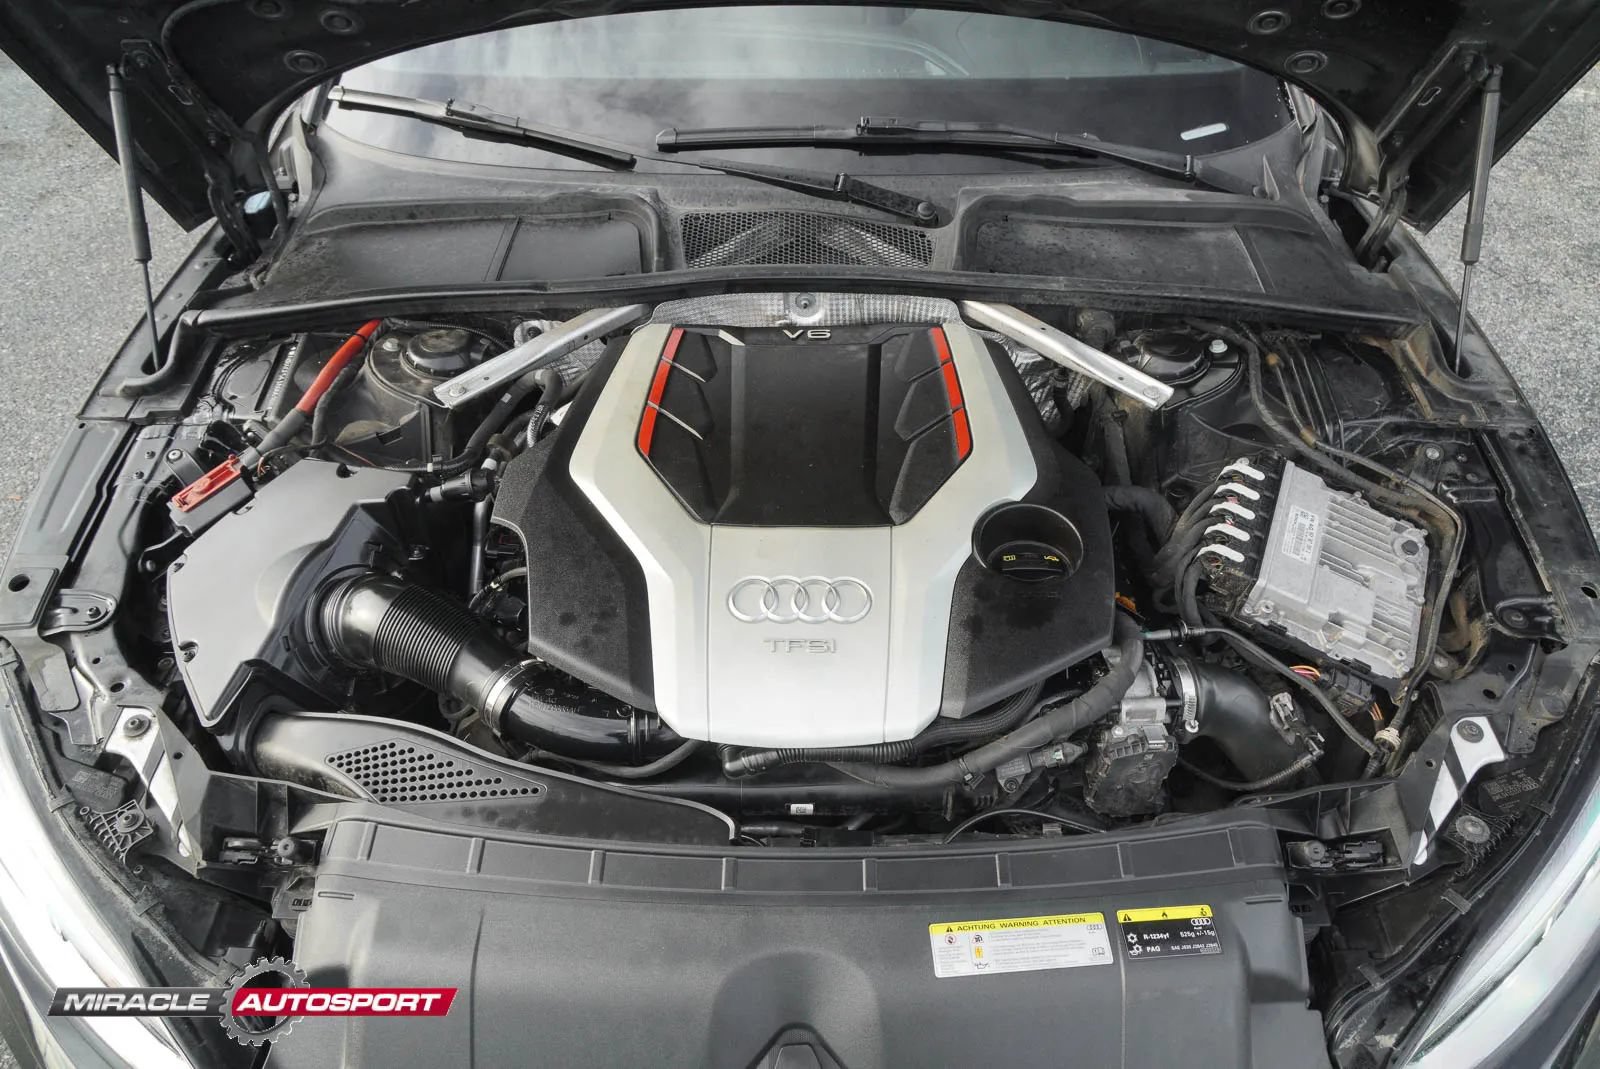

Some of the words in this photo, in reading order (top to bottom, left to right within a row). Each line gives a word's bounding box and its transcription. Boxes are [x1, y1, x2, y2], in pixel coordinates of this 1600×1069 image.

[782, 329, 831, 339] V6
[763, 638, 837, 654] TFSI
[957, 923, 996, 932] ACHTUNG
[1000, 919, 1039, 928] WARNING
[1043, 917, 1086, 926] ATTENTION
[1143, 932, 1170, 940] R-1234yf
[1146, 945, 1161, 953] PAG
